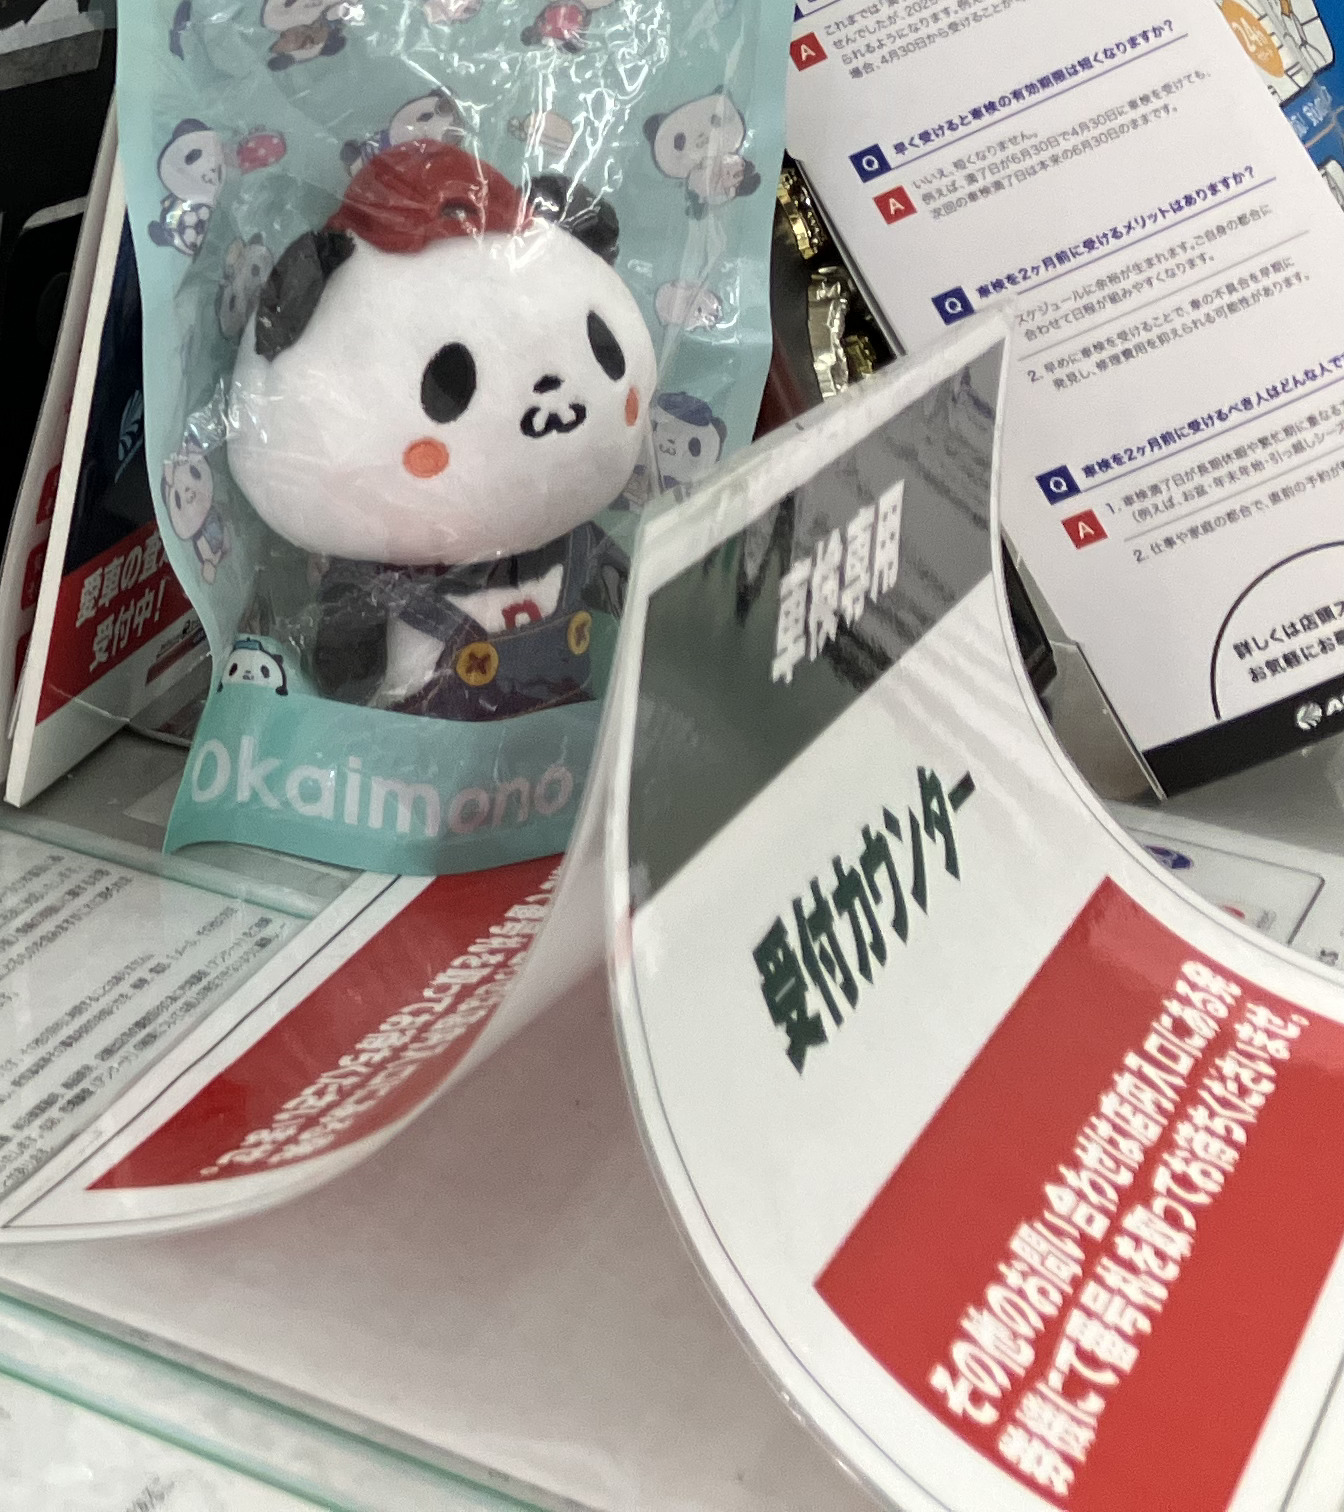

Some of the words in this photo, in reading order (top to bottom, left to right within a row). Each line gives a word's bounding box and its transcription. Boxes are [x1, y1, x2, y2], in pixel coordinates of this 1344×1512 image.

[798, 42, 817, 62] A
[892, 17, 1175, 158] 早く受けると車検の有効期限は短くなりますか?
[861, 154, 881, 173] Q
[887, 196, 906, 215] A
[911, 130, 1039, 191] いいえ、短くなりません。
[929, 104, 1178, 221] 次回の車検満了日は本来の6月30日のままです。
[975, 164, 1257, 302] 車検を2ヶ月前に受けるメリットはありますか?
[1014, 204, 1273, 328] スケジュールに余裕が生まれます。ご自身の都合に
[944, 297, 964, 316] Q
[1023, 252, 1217, 342] 合わせて日程が組みやすくなります。
[1052, 270, 1312, 392] 発見し、修理費用を抑えられる可能性があります。
[1048, 476, 1069, 494] Q
[1077, 520, 1096, 540] A
[75, 528, 170, 629] 愛車の査
[89, 575, 171, 673] 受付中!
[770, 477, 908, 686] 車検専用
[749, 765, 981, 1077] 受付カウンター
[927, 958, 1243, 1426] その他のお問い合わせは店内入口にある発
[997, 999, 1310, 1497] 券機にて番号札を取ってお待ちくださいませ。
